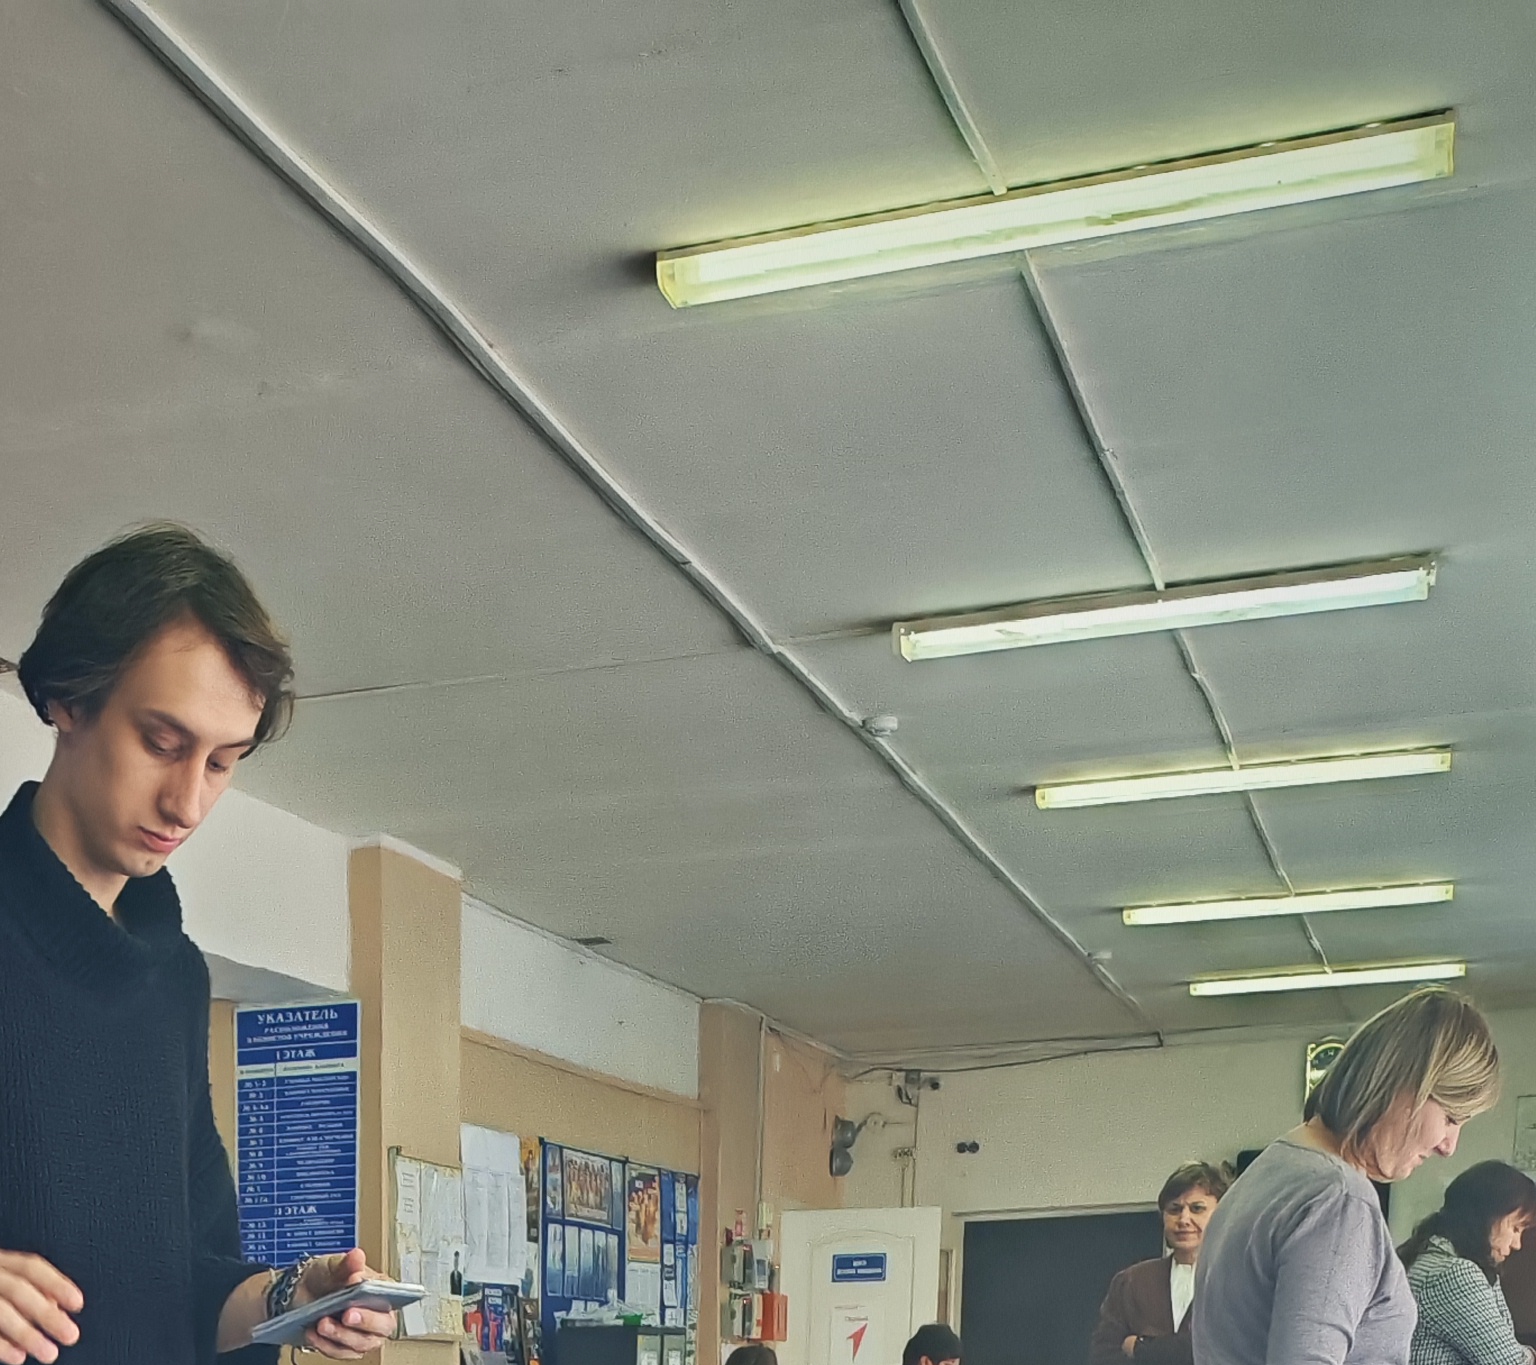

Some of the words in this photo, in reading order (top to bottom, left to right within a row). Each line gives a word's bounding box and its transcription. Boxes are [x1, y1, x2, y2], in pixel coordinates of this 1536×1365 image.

[257, 1009, 339, 1025] УКАЗАТЕЛЬ
[283, 1049, 316, 1060] ЭТАЖ
[284, 1205, 318, 1216] ЭТАЖ
